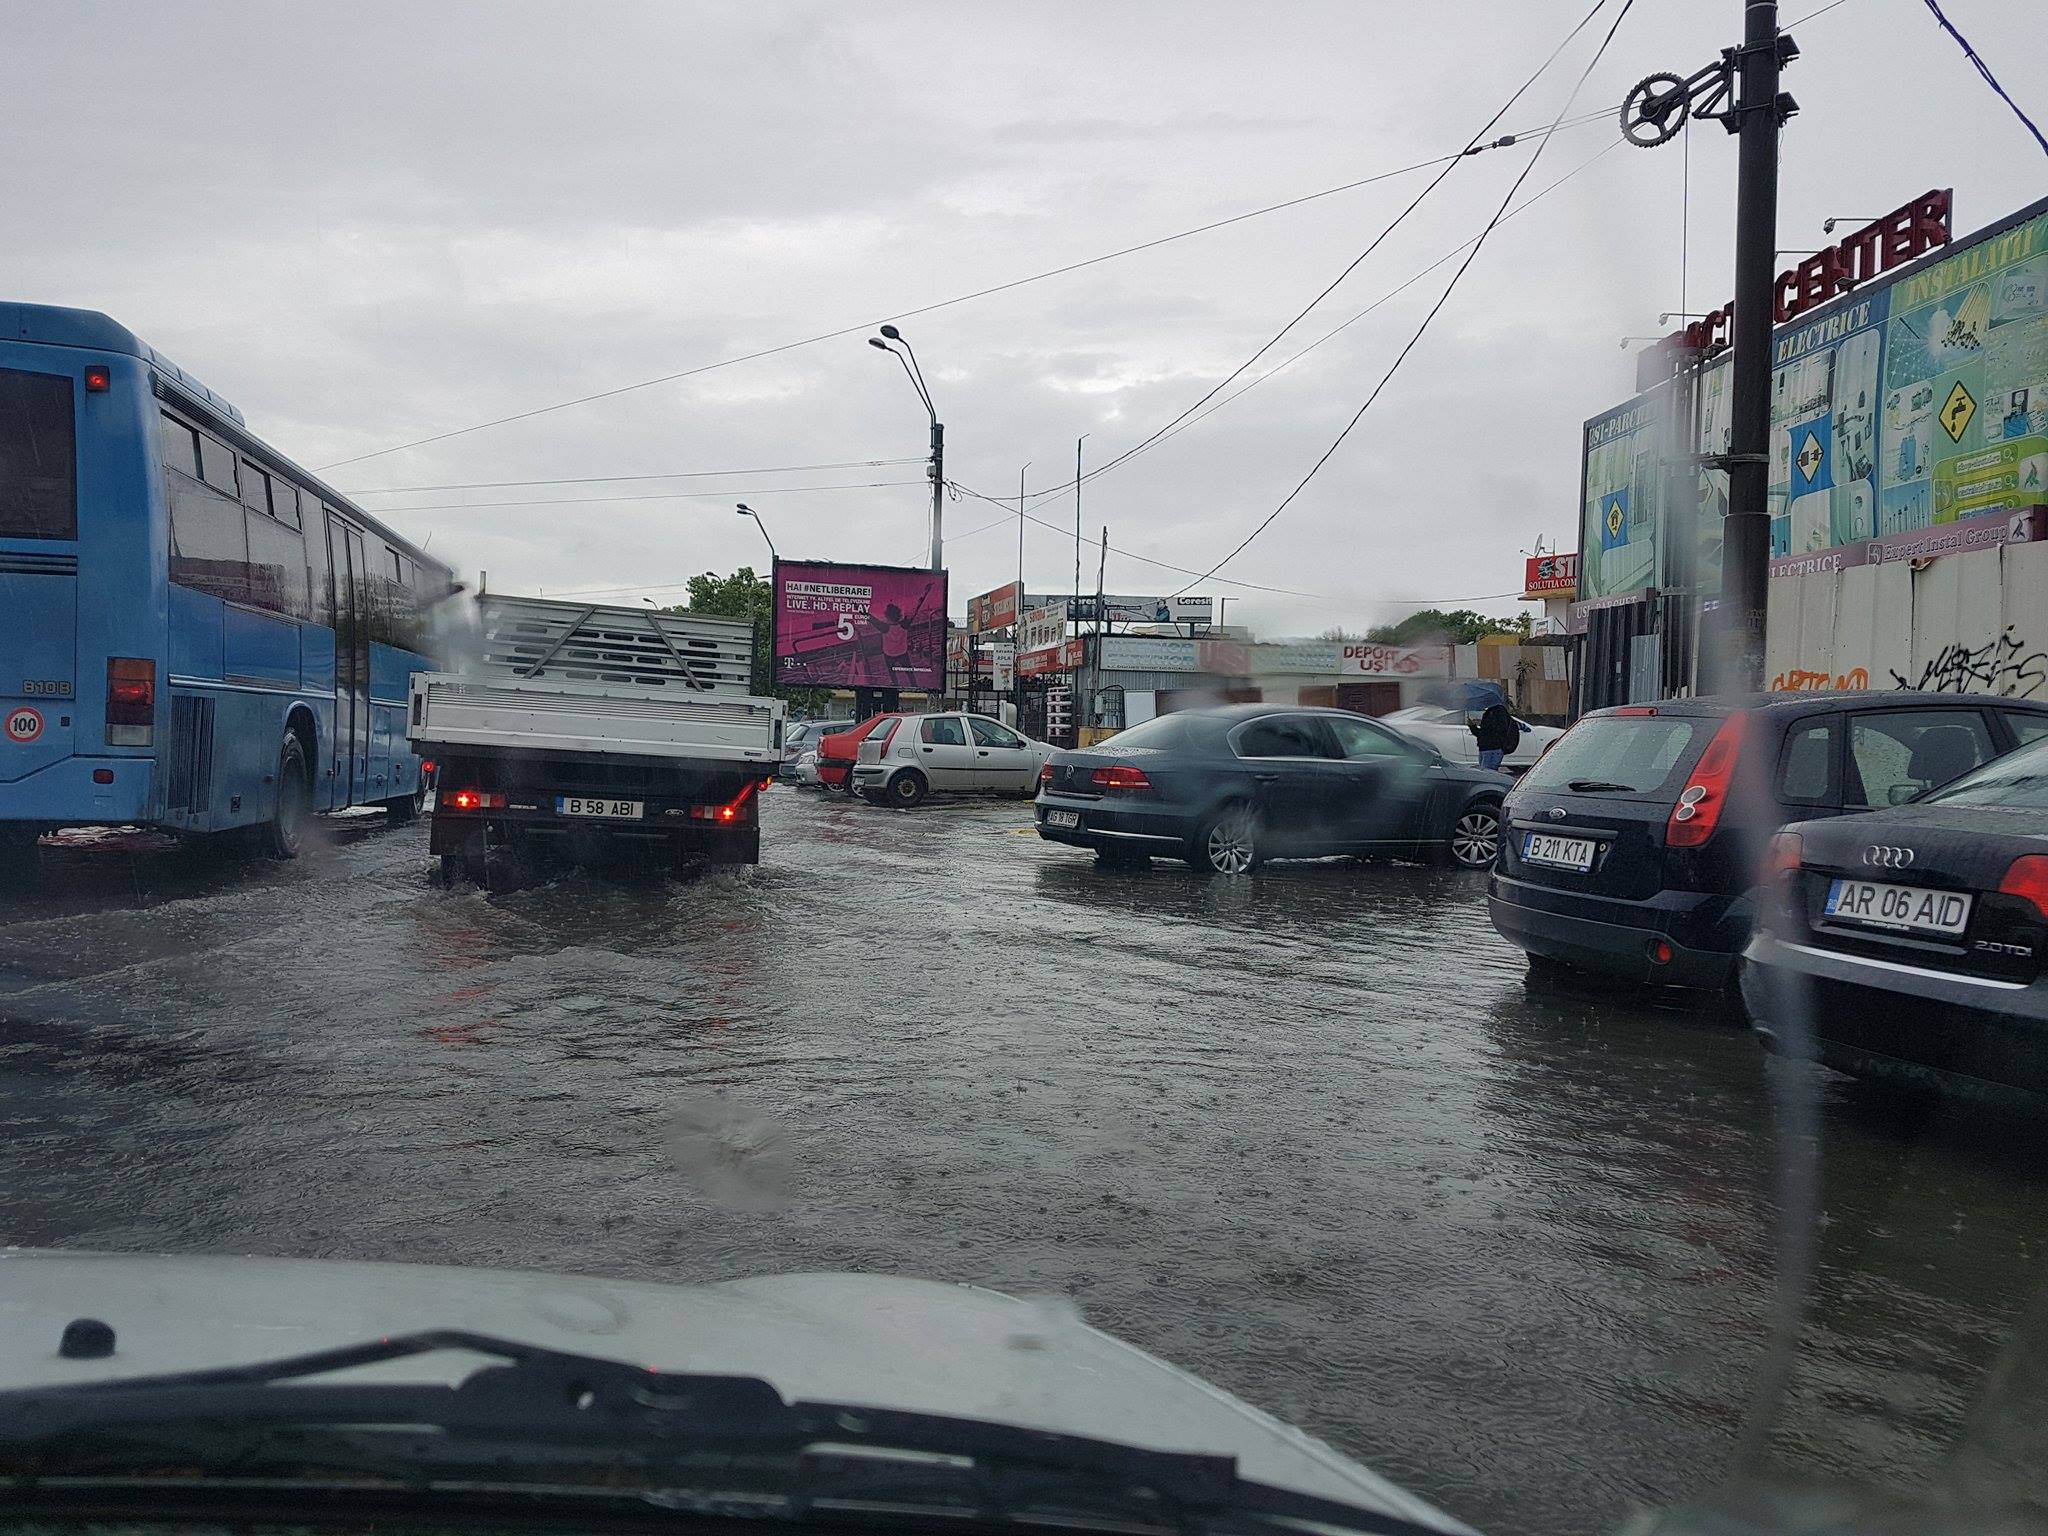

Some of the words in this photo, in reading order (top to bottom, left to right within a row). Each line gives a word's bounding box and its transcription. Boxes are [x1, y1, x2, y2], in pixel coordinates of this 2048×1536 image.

[1774, 188, 1951, 323] CENTER
[1777, 301, 1871, 363] ELECTRICE
[1884, 541, 1923, 560] Expert
[1925, 530, 1962, 552] Instal
[1966, 525, 2008, 544] Group
[1771, 554, 1842, 578] LECTRICE
[787, 583, 802, 591] HAI
[804, 585, 871, 596] #NETLIBERARE!
[1528, 579, 1559, 590] SOLUTIA
[787, 600, 810, 609] LIVE.
[813, 602, 830, 611] HD.
[833, 603, 871, 613] REPLAY
[837, 613, 855, 640] 5
[13, 717, 37, 731] 100
[570, 800, 581, 813] B
[586, 801, 604, 814] 58
[611, 802, 634, 816] ABI
[1531, 838, 1542, 855] B
[1543, 839, 1561, 859] 211
[1563, 841, 1588, 863] KTA
[1838, 885, 1876, 915] AR
[1880, 889, 1913, 918] 06
[1913, 894, 1966, 927] AID
